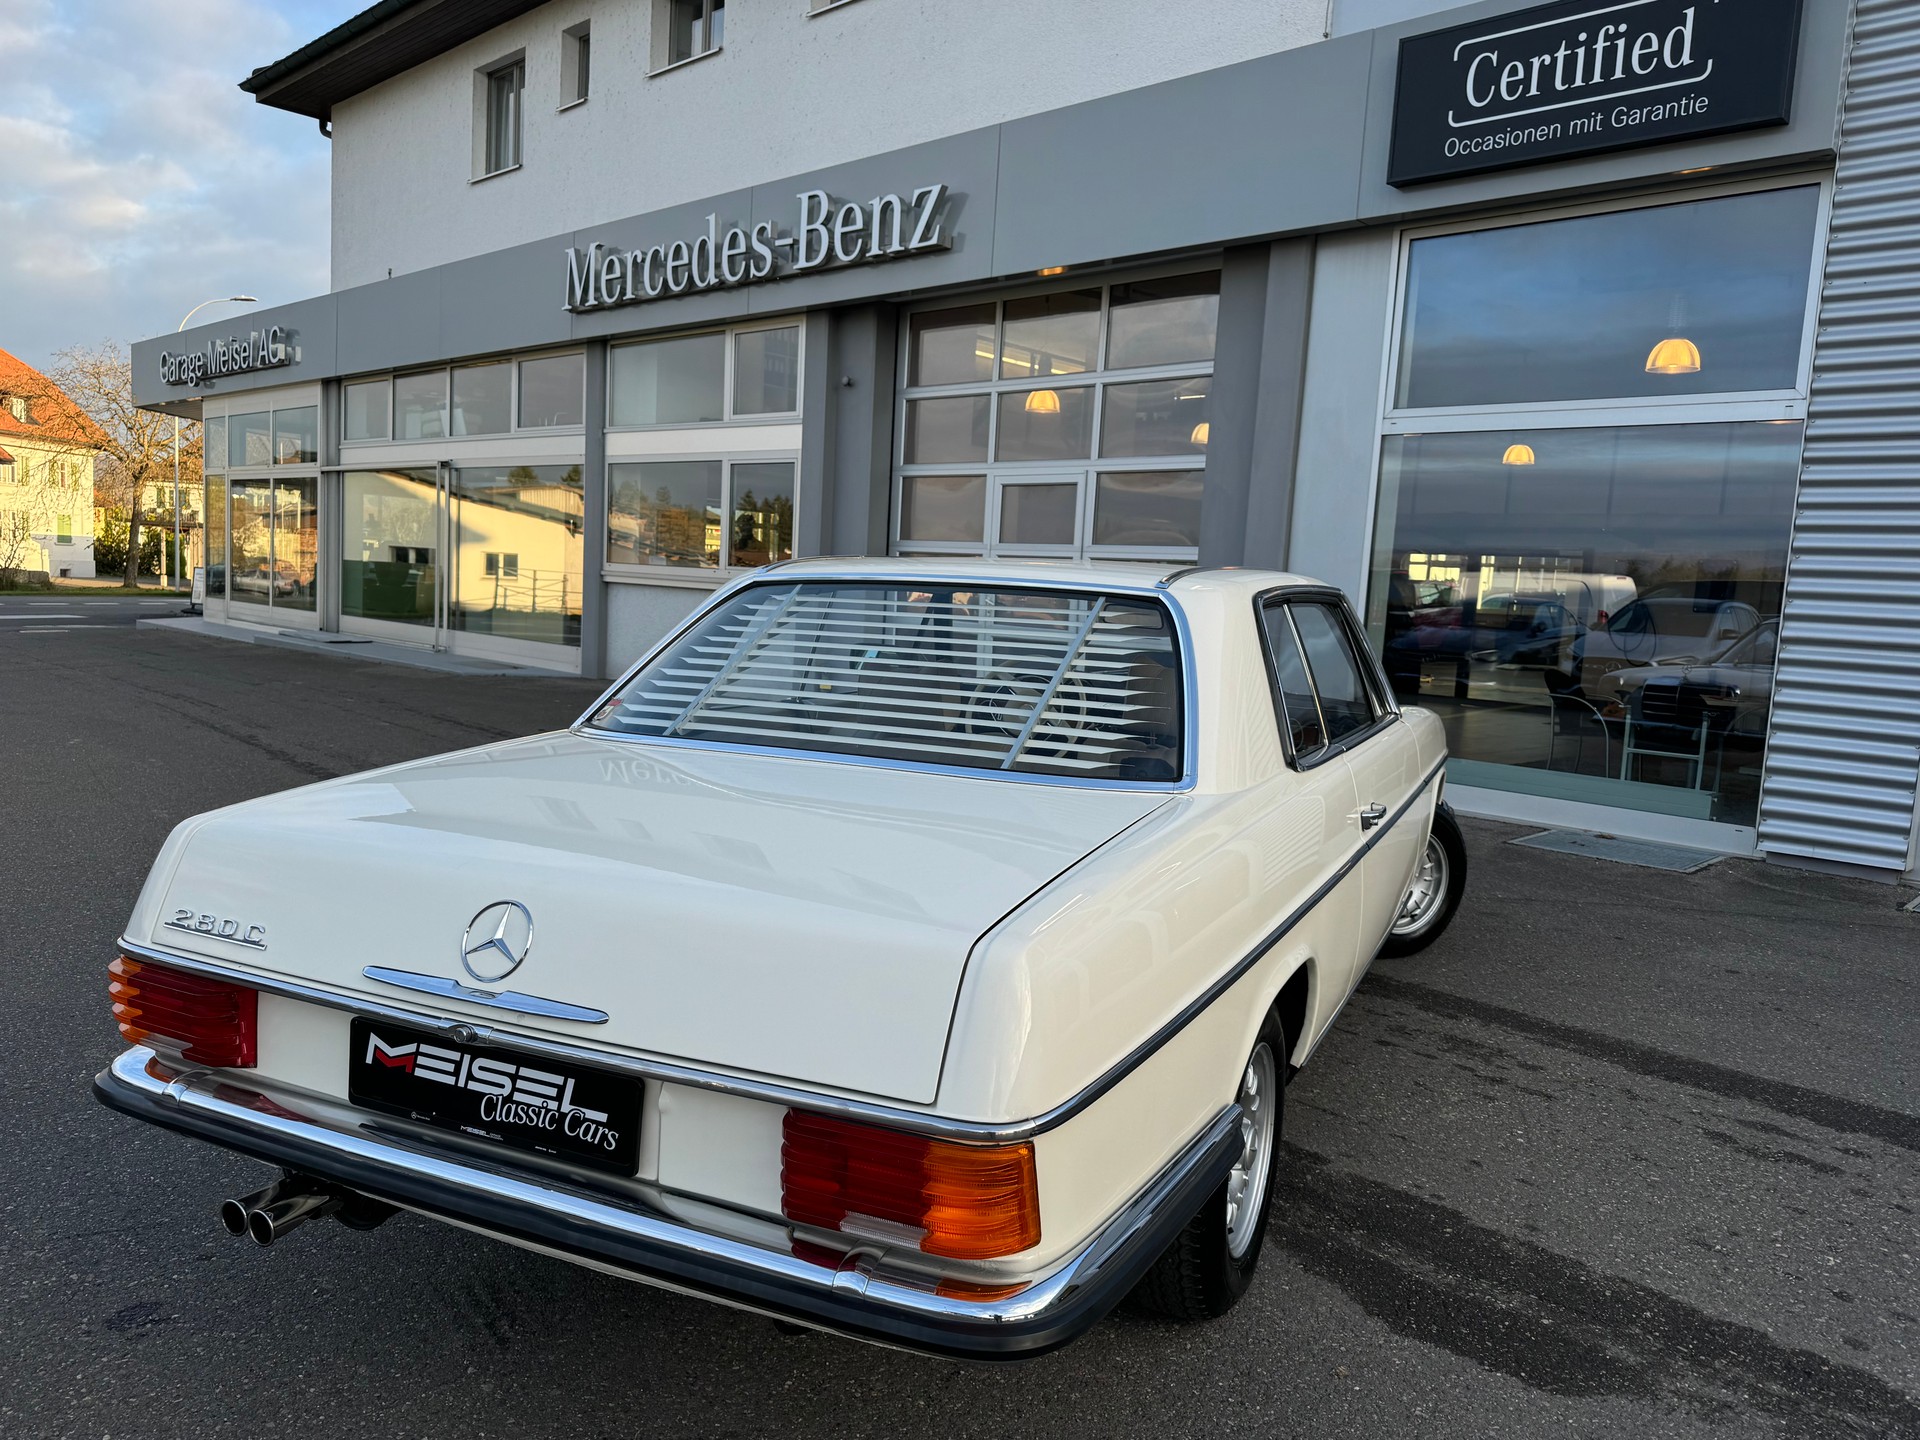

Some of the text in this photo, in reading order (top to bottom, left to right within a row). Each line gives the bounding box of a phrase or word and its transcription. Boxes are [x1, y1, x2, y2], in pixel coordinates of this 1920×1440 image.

[1465, 7, 1695, 108] Certified
[1444, 93, 1709, 157] Occasionen mit Garantie
[562, 183, 948, 311] Mercedes-Benz
[160, 326, 283, 387] Garage Meisel AG
[365, 1032, 608, 1122] MEISEL
[480, 1094, 619, 1150] Classic Cars
